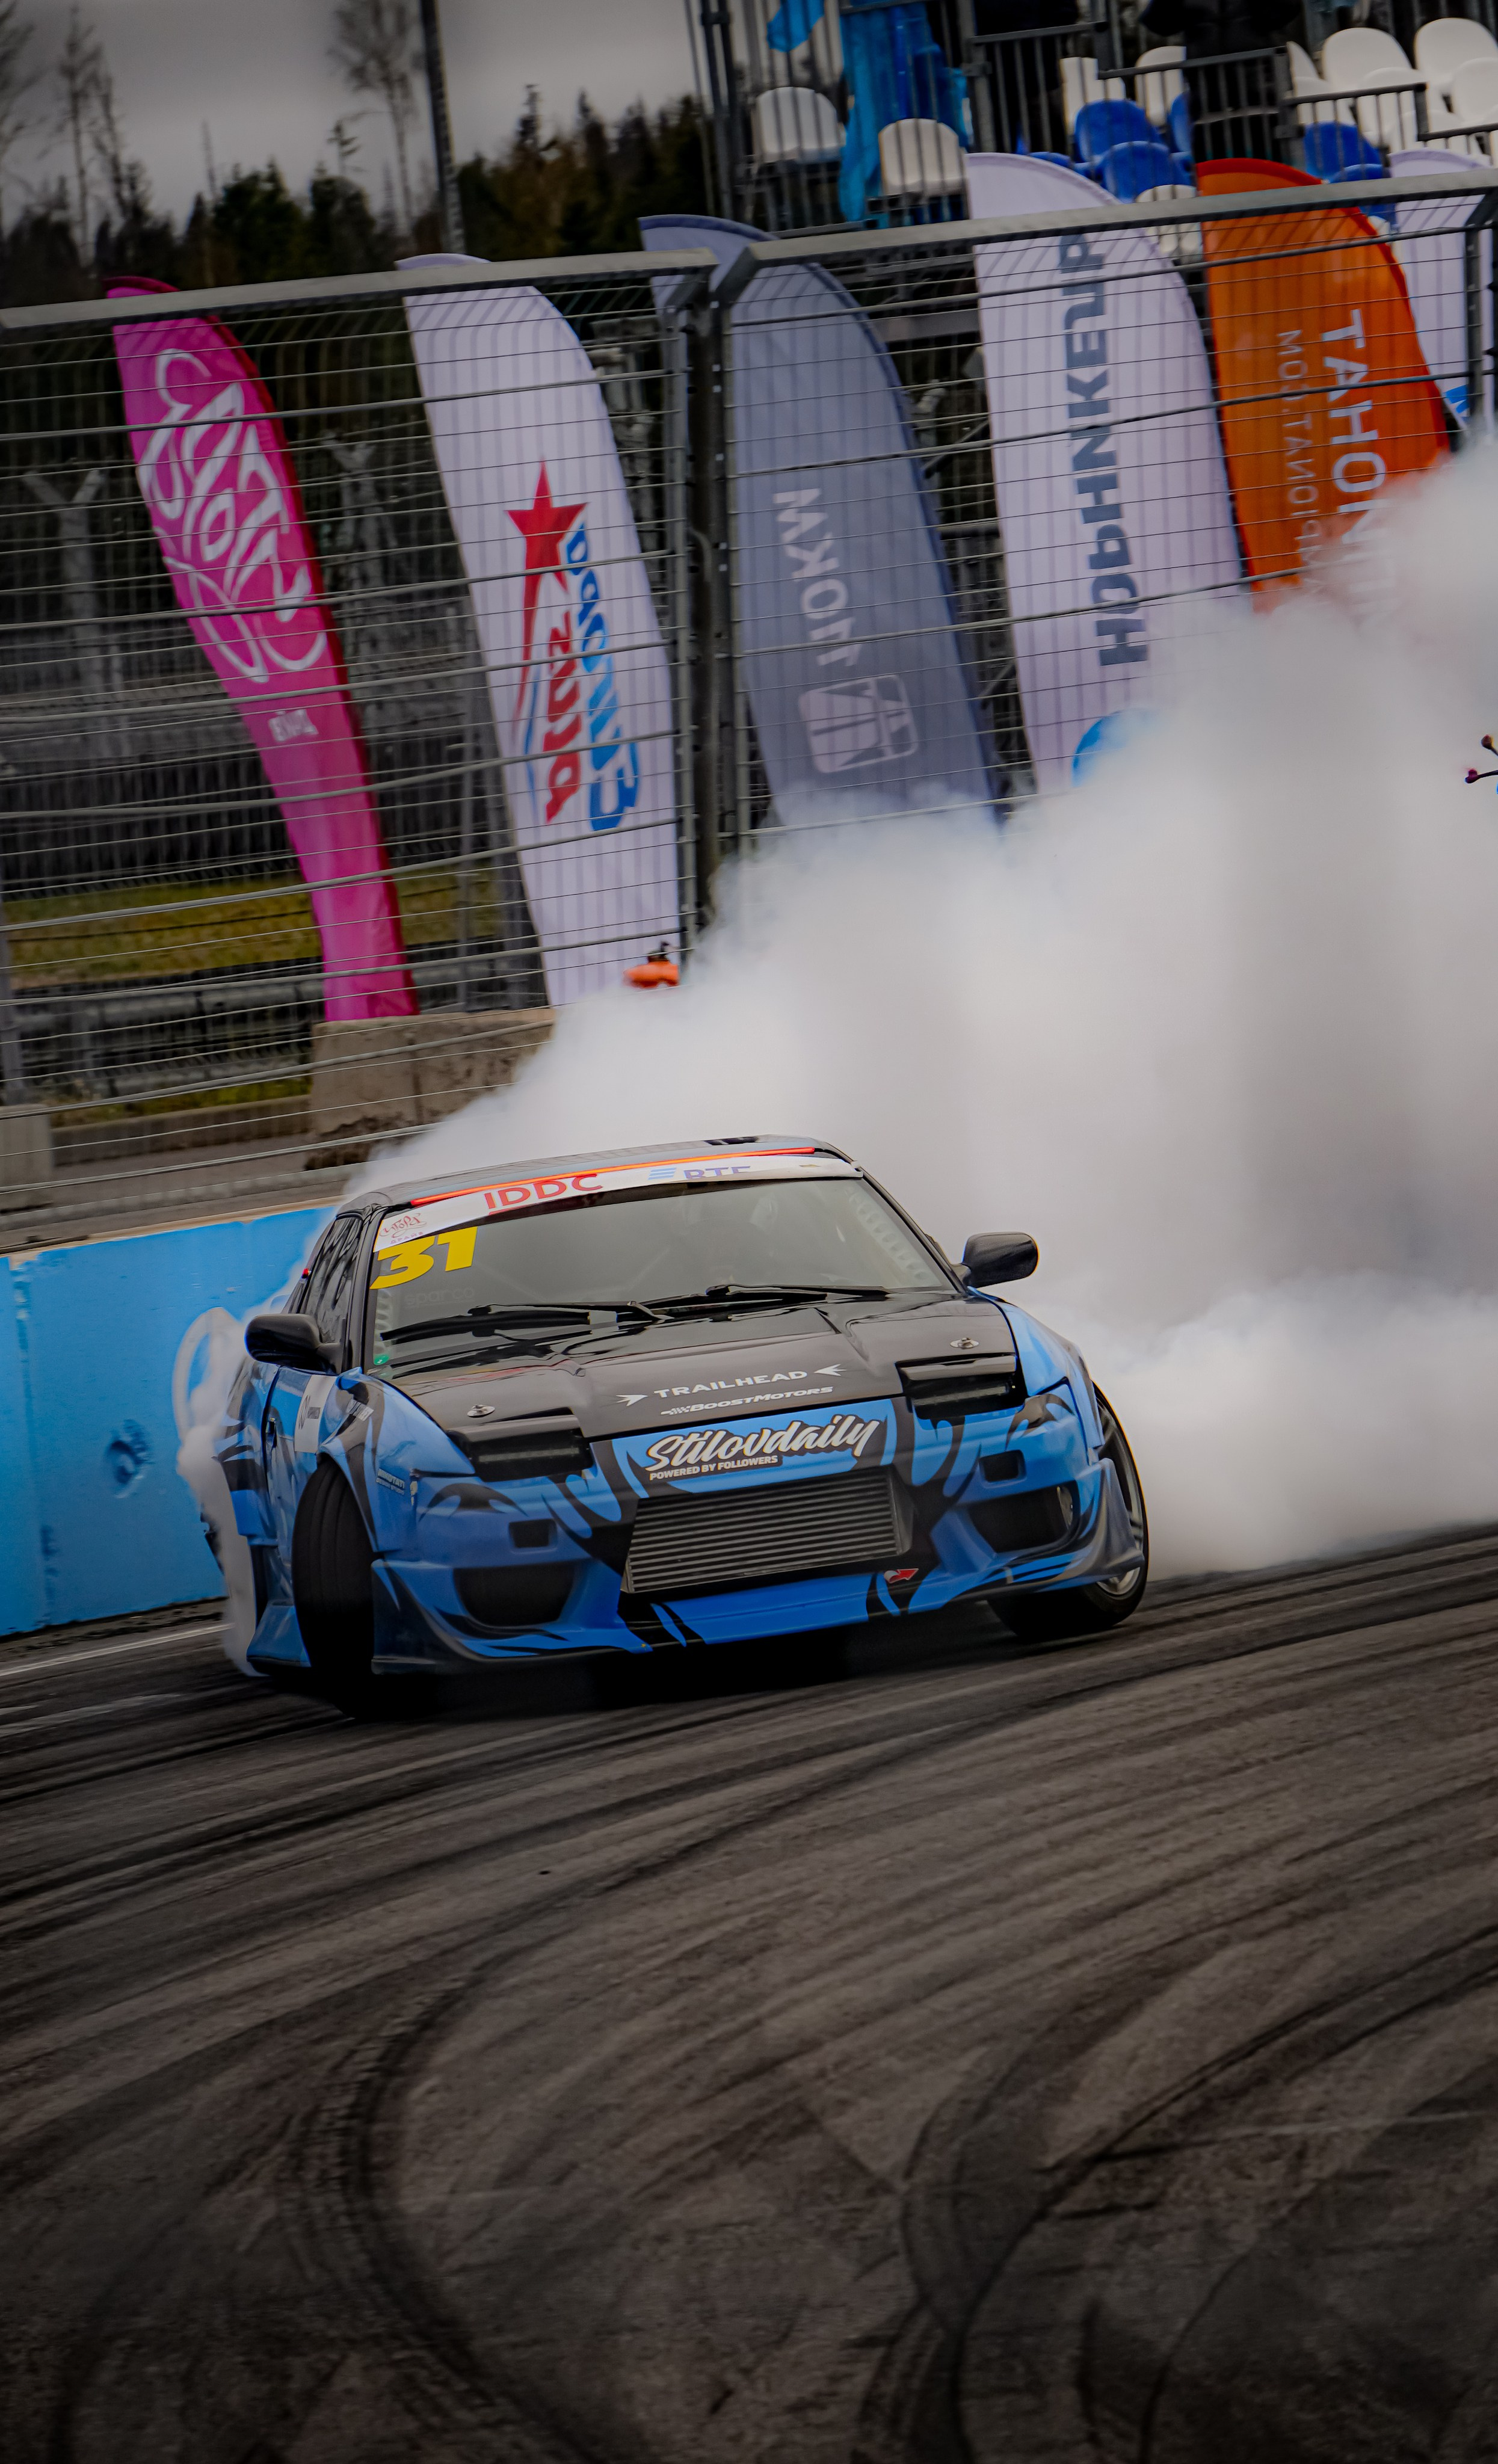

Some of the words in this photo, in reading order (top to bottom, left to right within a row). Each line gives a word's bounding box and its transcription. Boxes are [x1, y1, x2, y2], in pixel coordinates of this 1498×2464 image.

[483, 1172, 603, 1211] IDDC
[369, 1226, 478, 1290] 31
[653, 1370, 808, 1399] TRAILHEAD
[644, 1414, 880, 1471] Stilovdaily
[649, 1465, 701, 1481] POWERED
[701, 1463, 717, 1473] BY
[717, 1455, 778, 1471] FOLLOWERS
